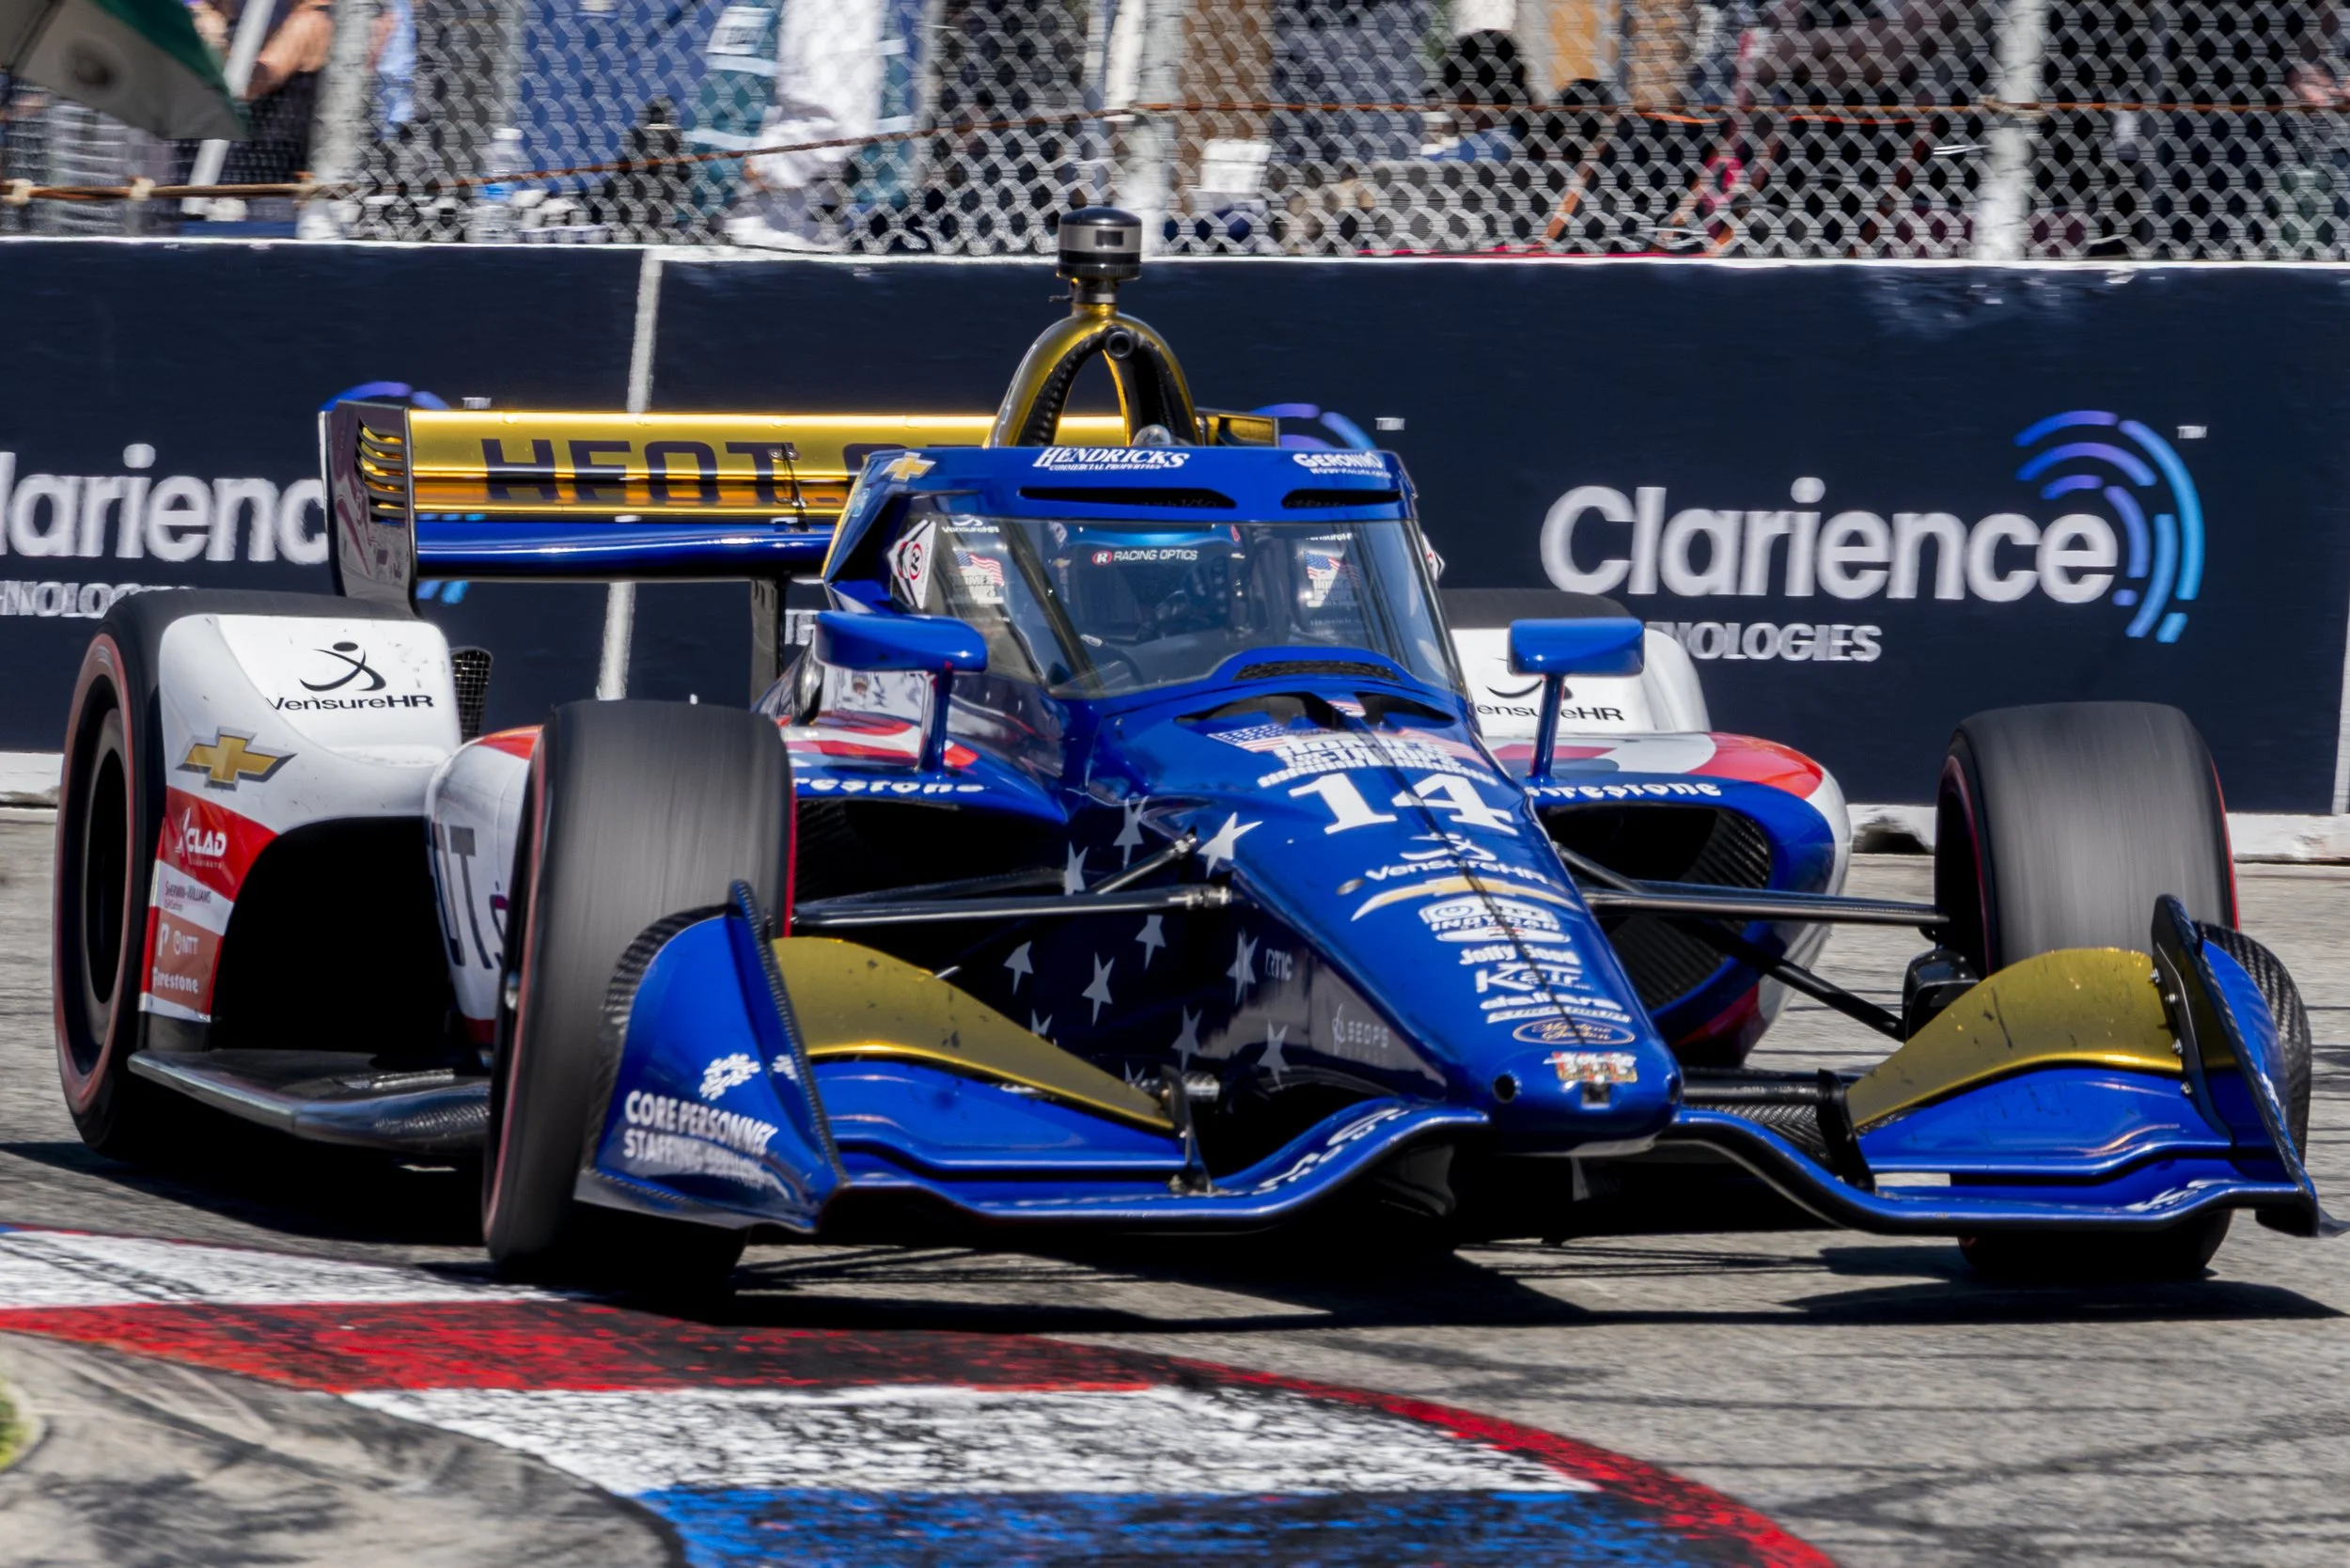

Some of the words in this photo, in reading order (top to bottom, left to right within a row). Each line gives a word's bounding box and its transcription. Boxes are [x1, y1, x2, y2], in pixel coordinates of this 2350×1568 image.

[1033, 446, 1191, 468] HENDRICKS
[0, 443, 327, 565] arienc
[1540, 477, 2118, 604] Clarience
[1113, 550, 1158, 561] RACING
[1159, 549, 1198, 561] OPTICS
[266, 695, 434, 712] VensureHR
[1288, 773, 1520, 836] 14
[182, 935, 199, 955] NTT
[1459, 944, 1517, 965] Jolly
[152, 966, 199, 995] Firestone
[625, 1090, 679, 1131] CORE
